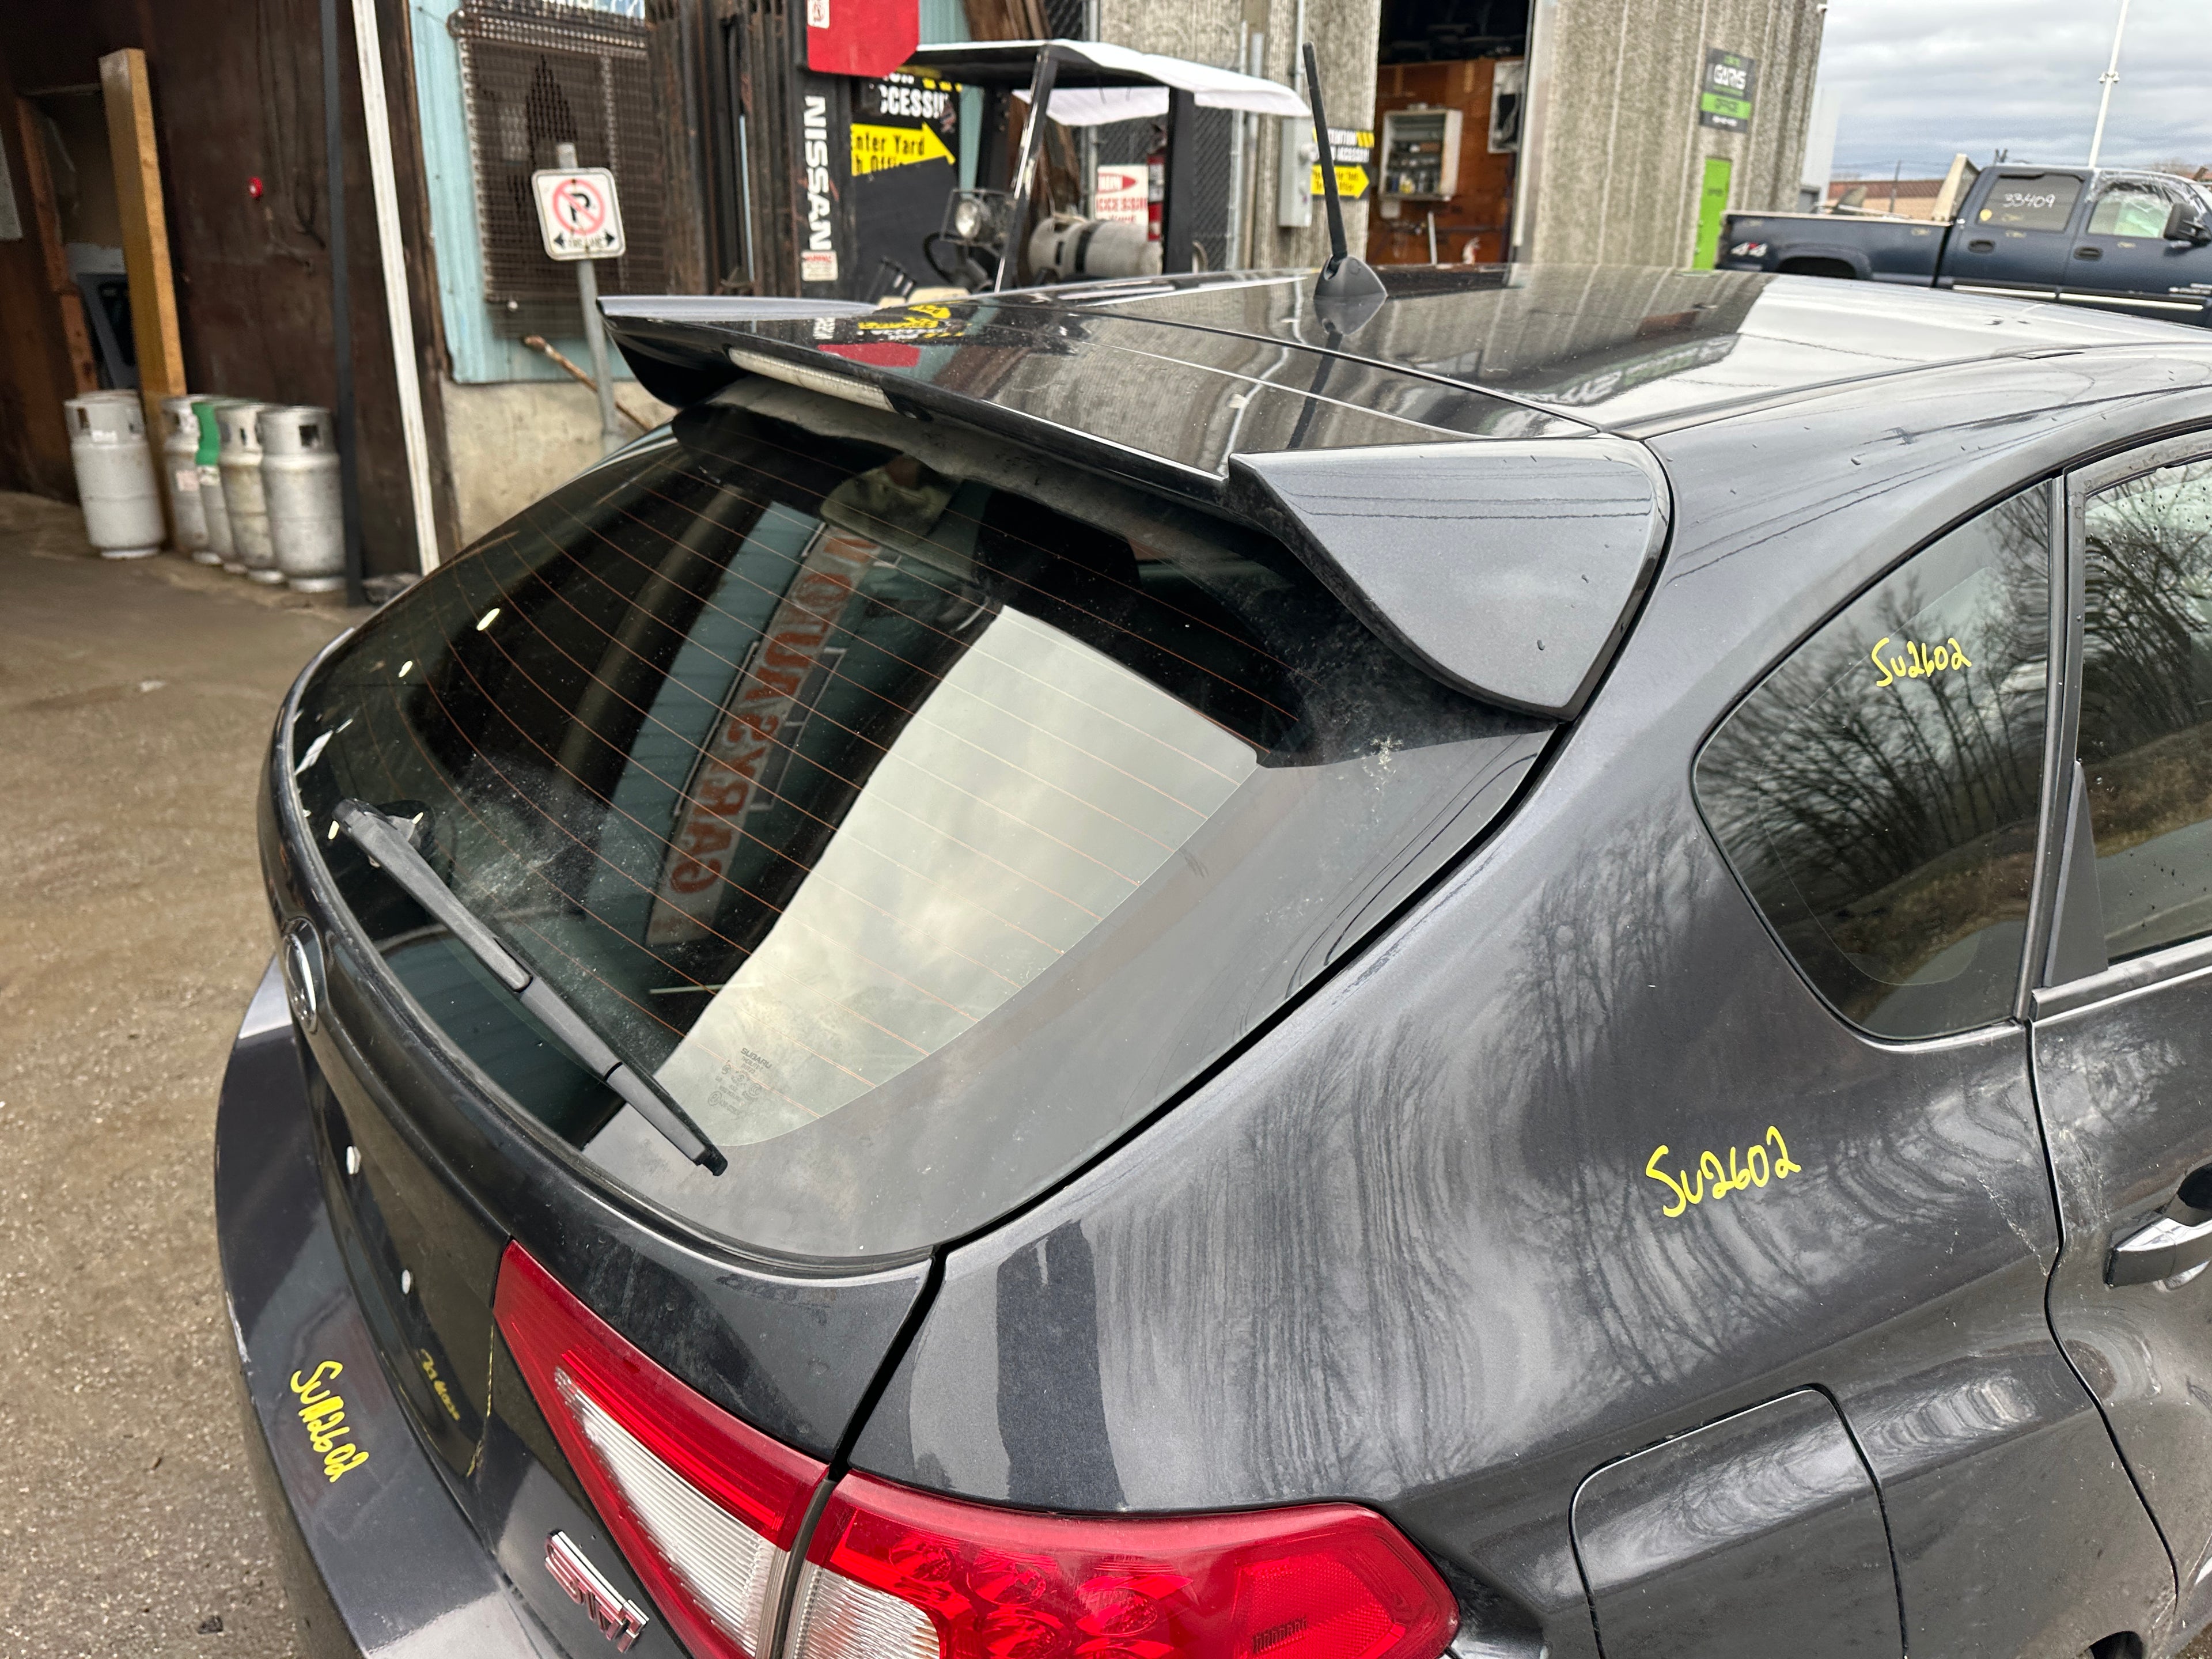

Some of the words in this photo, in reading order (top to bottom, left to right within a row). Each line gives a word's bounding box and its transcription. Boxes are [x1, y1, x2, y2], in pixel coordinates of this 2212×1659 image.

[892, 134, 925, 156] Yard
[804, 96, 832, 251] NISSAN
[2002, 193, 2055, 208] 33409
[741, 1047, 772, 1069] SUBARU
